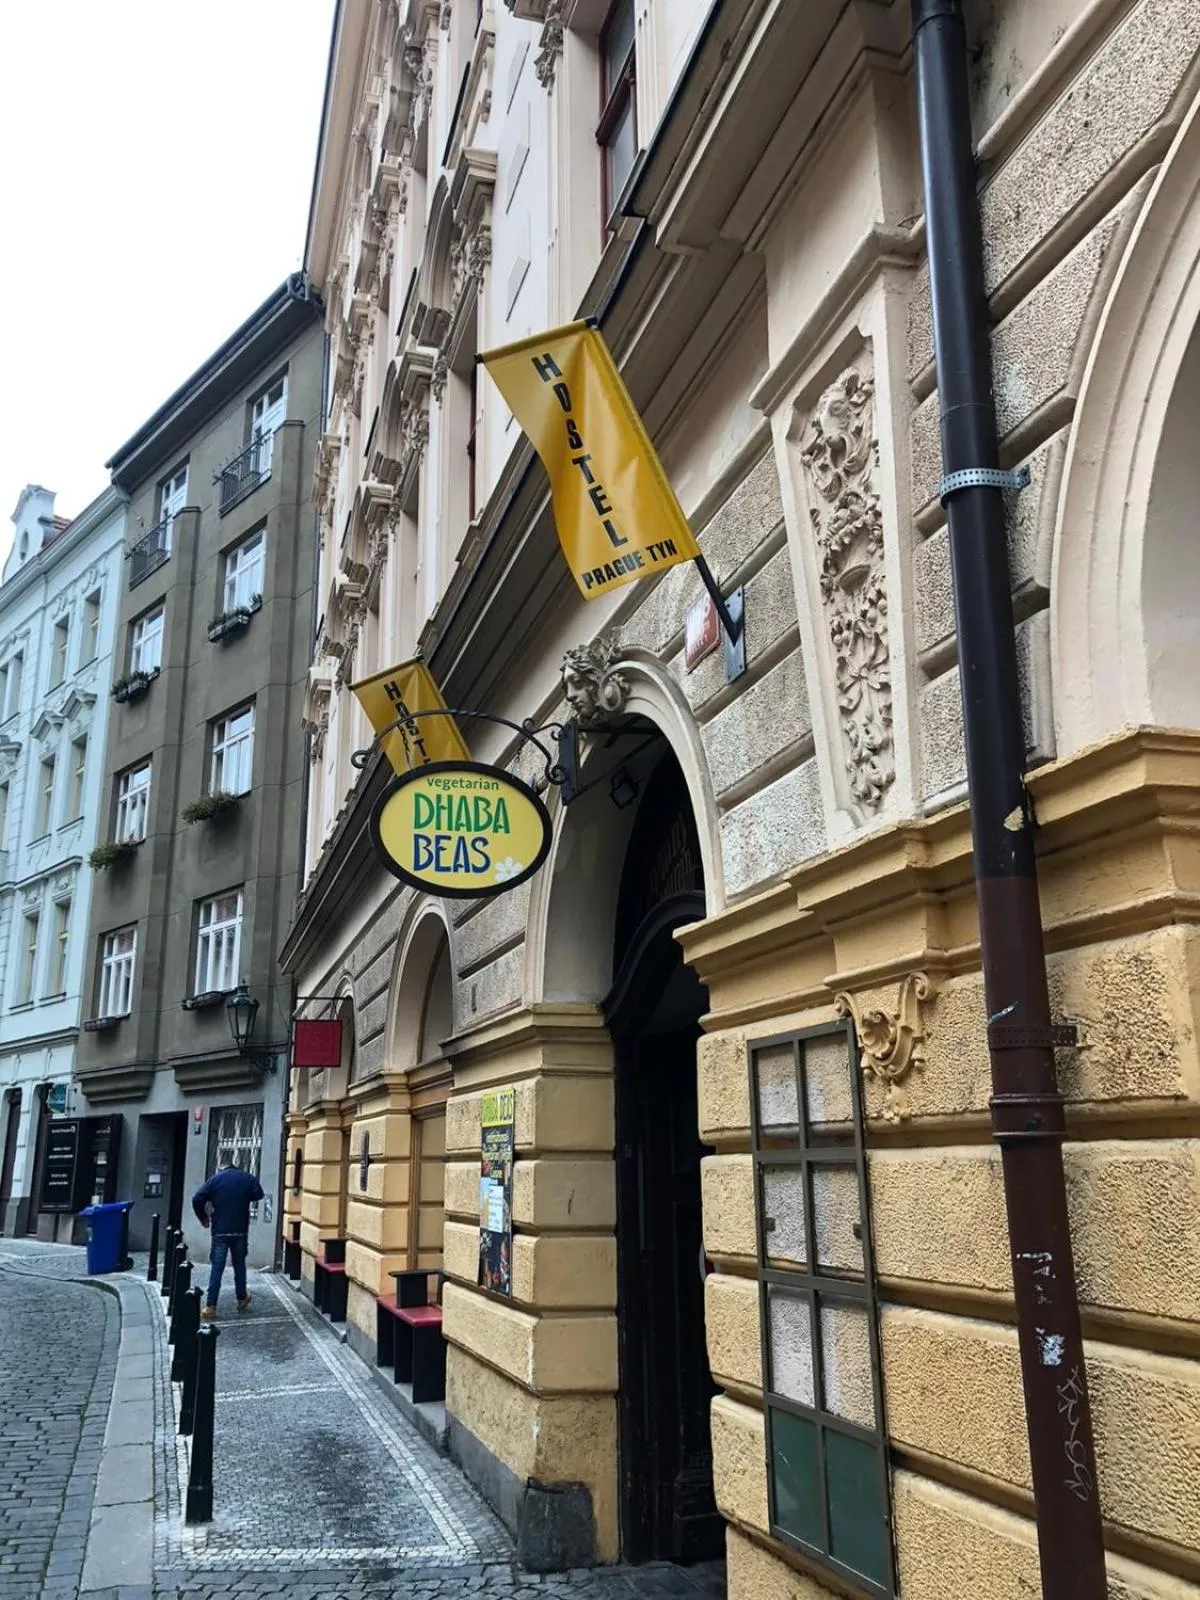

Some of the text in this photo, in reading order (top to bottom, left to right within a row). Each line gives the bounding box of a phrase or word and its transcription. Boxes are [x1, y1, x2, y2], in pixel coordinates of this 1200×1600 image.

[531, 352, 629, 549] HOSTEL
[582, 538, 678, 590] PRAGUE TYN
[383, 681, 431, 764] HOST
[427, 776, 500, 792] vegetarian
[413, 792, 511, 834] DHABA
[413, 834, 492, 874] BEAS
